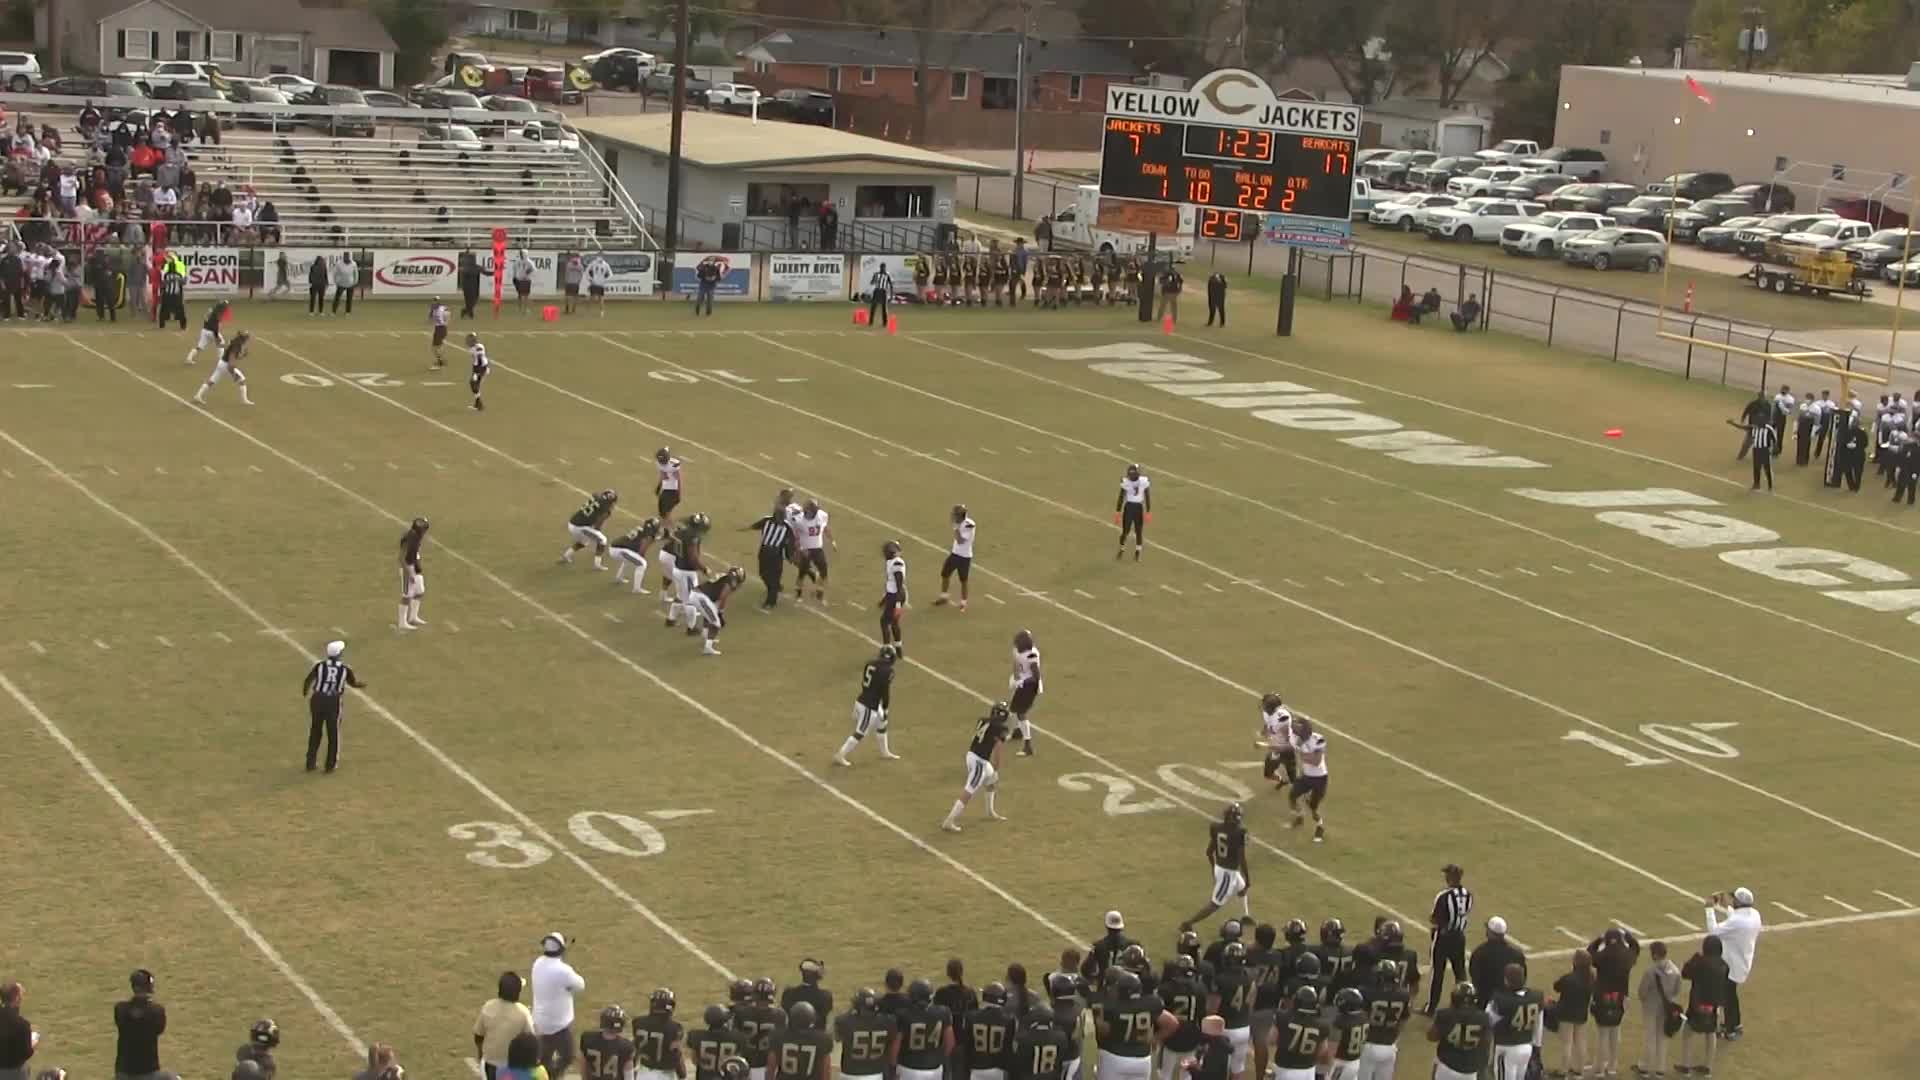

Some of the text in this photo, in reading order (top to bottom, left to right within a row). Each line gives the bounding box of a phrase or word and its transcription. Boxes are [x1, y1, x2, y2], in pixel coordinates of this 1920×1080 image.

[1111, 90, 1356, 132] YELLOW JACKETS
[1107, 120, 1161, 135] JACKETS
[1129, 135, 1141, 156] 7
[1217, 130, 1271, 159] 1:23
[1302, 137, 1351, 152] BEARCATS
[1142, 163, 1167, 176] DOWN
[1324, 154, 1347, 176] 17
[1162, 179, 1169, 198] 1
[1190, 181, 1210, 203] 10
[1239, 185, 1269, 208] 22
[1281, 189, 1295, 211] 2
[1203, 210, 1239, 238] 25
[189, 268, 237, 284] SAN
[393, 264, 444, 275] ENGLAND
[326, 666, 338, 682] R
[863, 665, 876, 687] 5
[1560, 723, 1740, 766] 10
[1058, 764, 1254, 816] 20
[448, 811, 666, 868] 30
[1216, 833, 1228, 858] 6
[910, 1023, 943, 1053] 64
[972, 1025, 1006, 1053] 80
[1120, 1012, 1151, 1042] 79
[1288, 1023, 1319, 1054] 76
[1448, 1025, 1482, 1050] 45
[636, 1030, 664, 1063] 27
[852, 1031, 888, 1059] 55
[586, 1049, 618, 1079] 34
[782, 1043, 816, 1074] 67
[1033, 1045, 1058, 1074] 18
